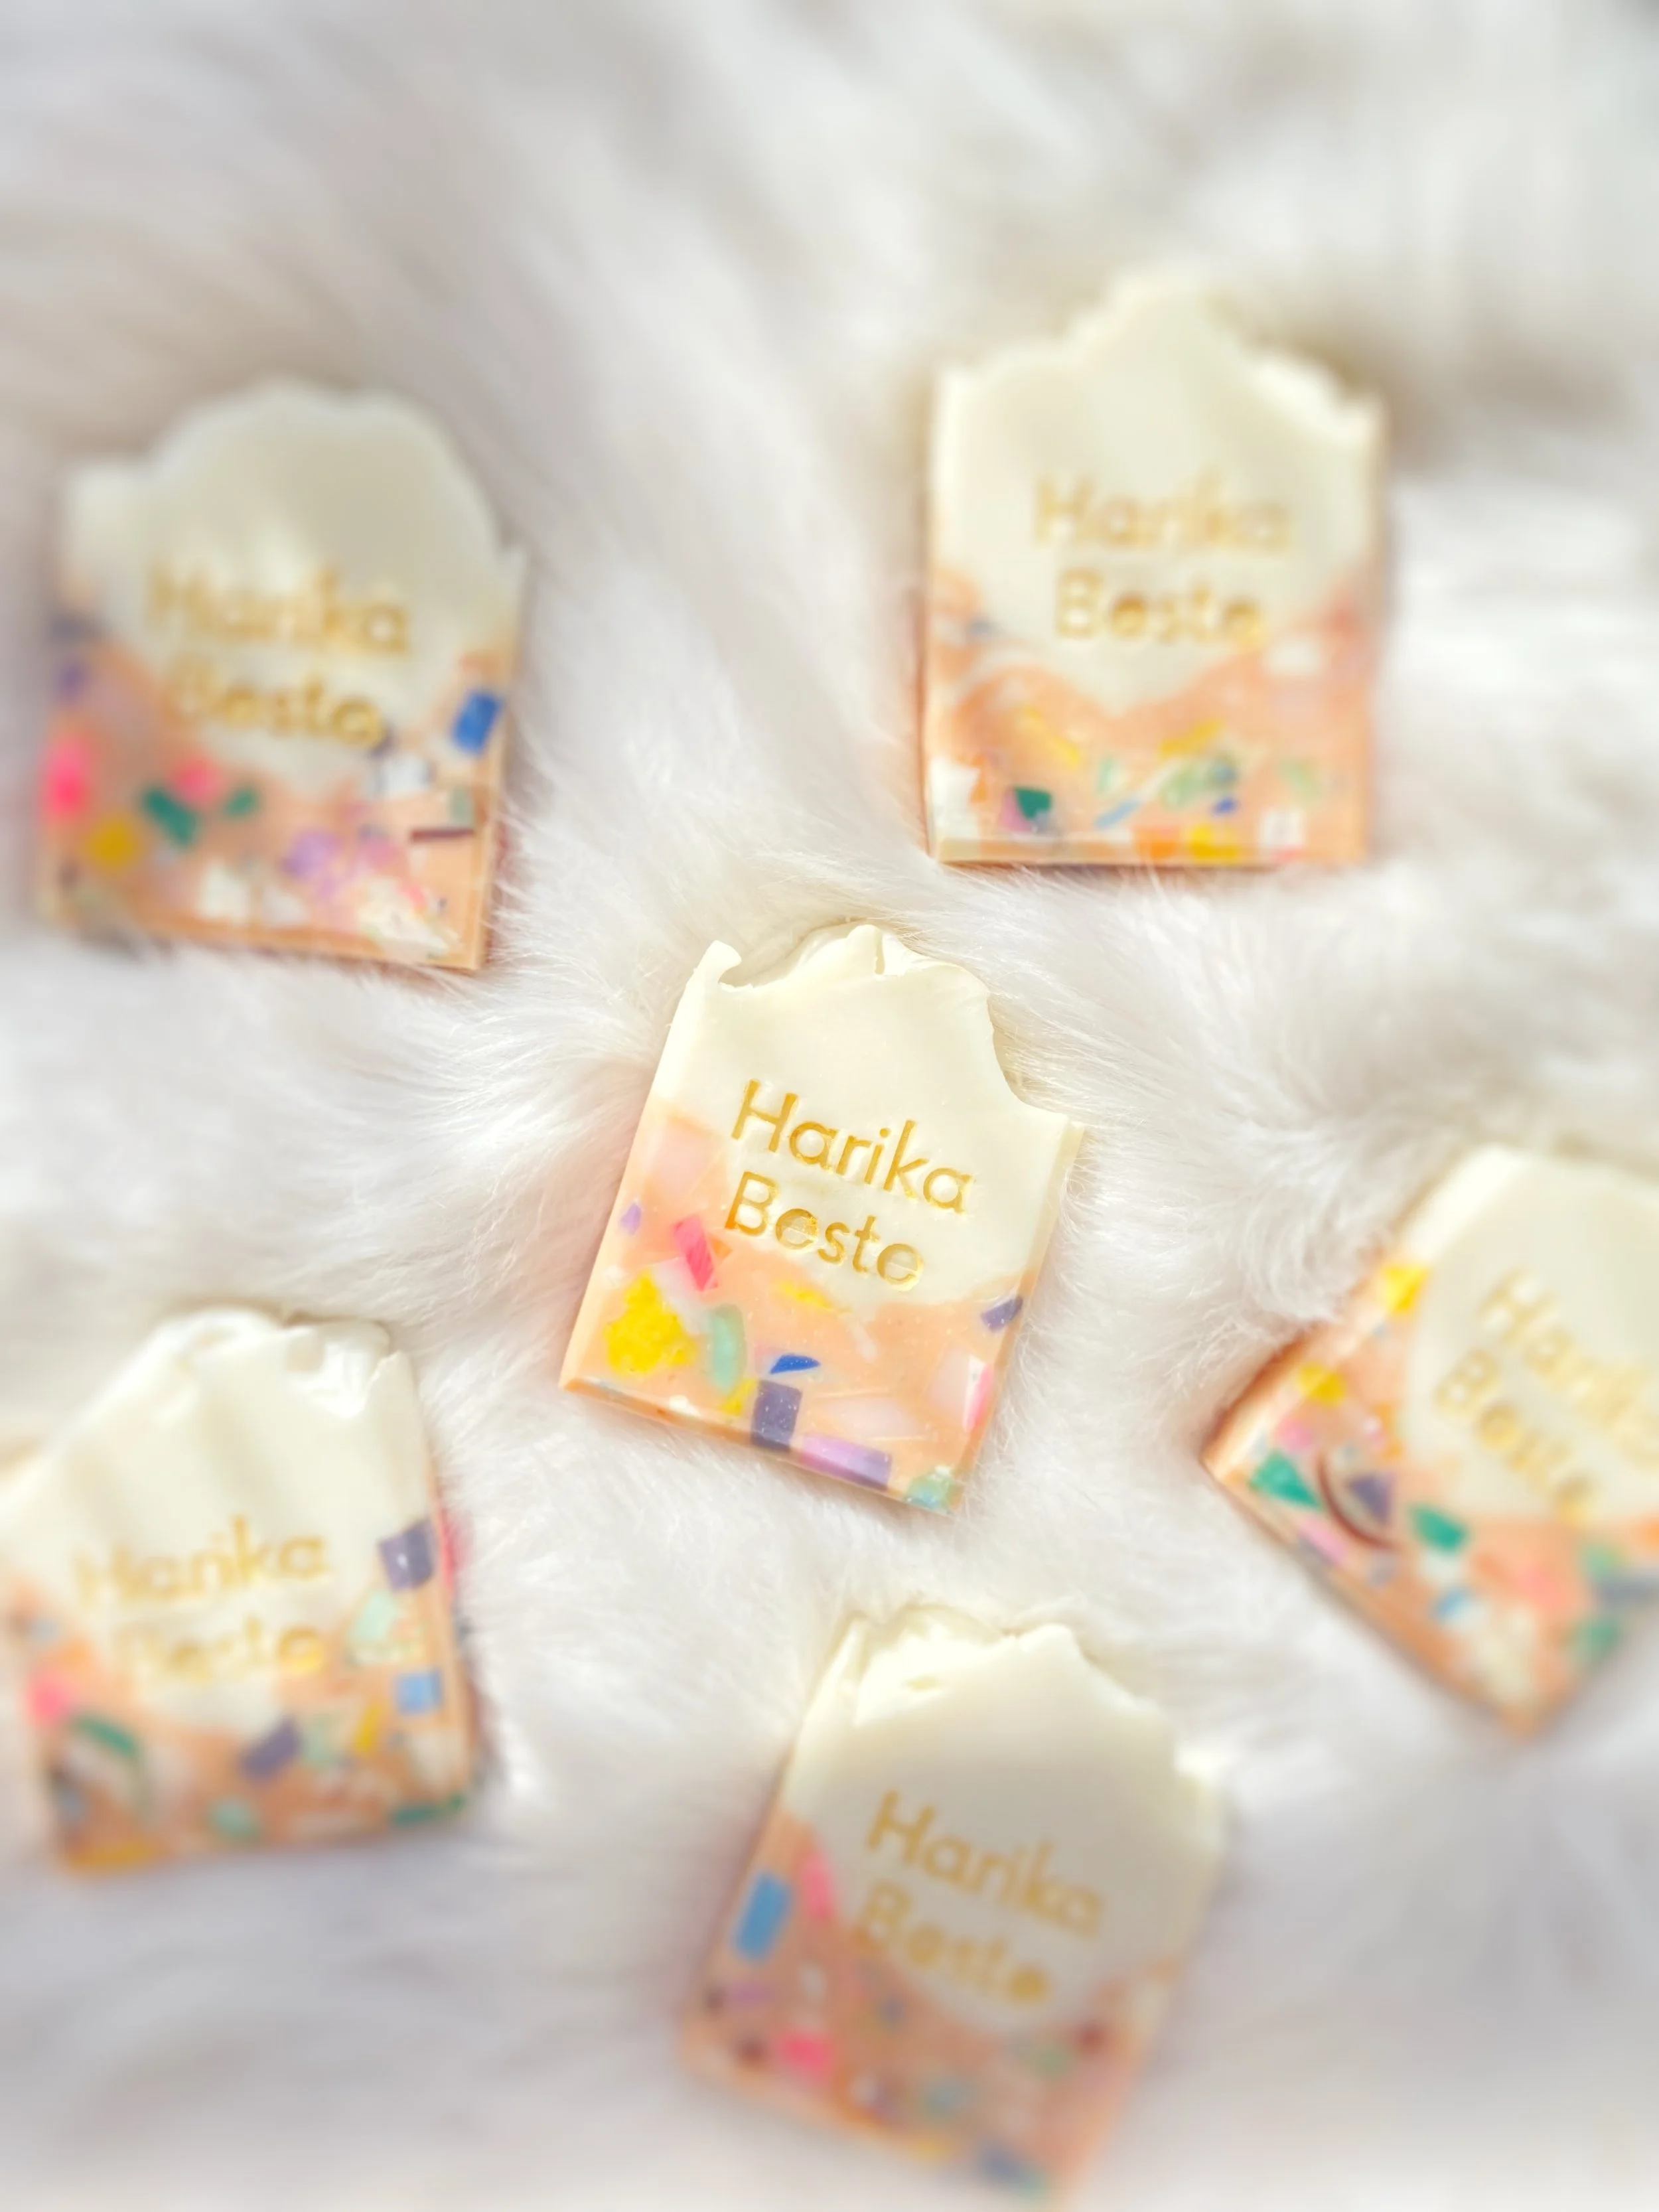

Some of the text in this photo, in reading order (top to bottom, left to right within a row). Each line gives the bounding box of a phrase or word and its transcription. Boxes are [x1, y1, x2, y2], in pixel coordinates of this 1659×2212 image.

[1054, 567, 1267, 645] Beste
[731, 1078, 974, 1215] Harika
[724, 1171, 924, 1291] Beste
[868, 1789, 1104, 1941] Harika
[853, 1880, 1050, 2006] Beste
